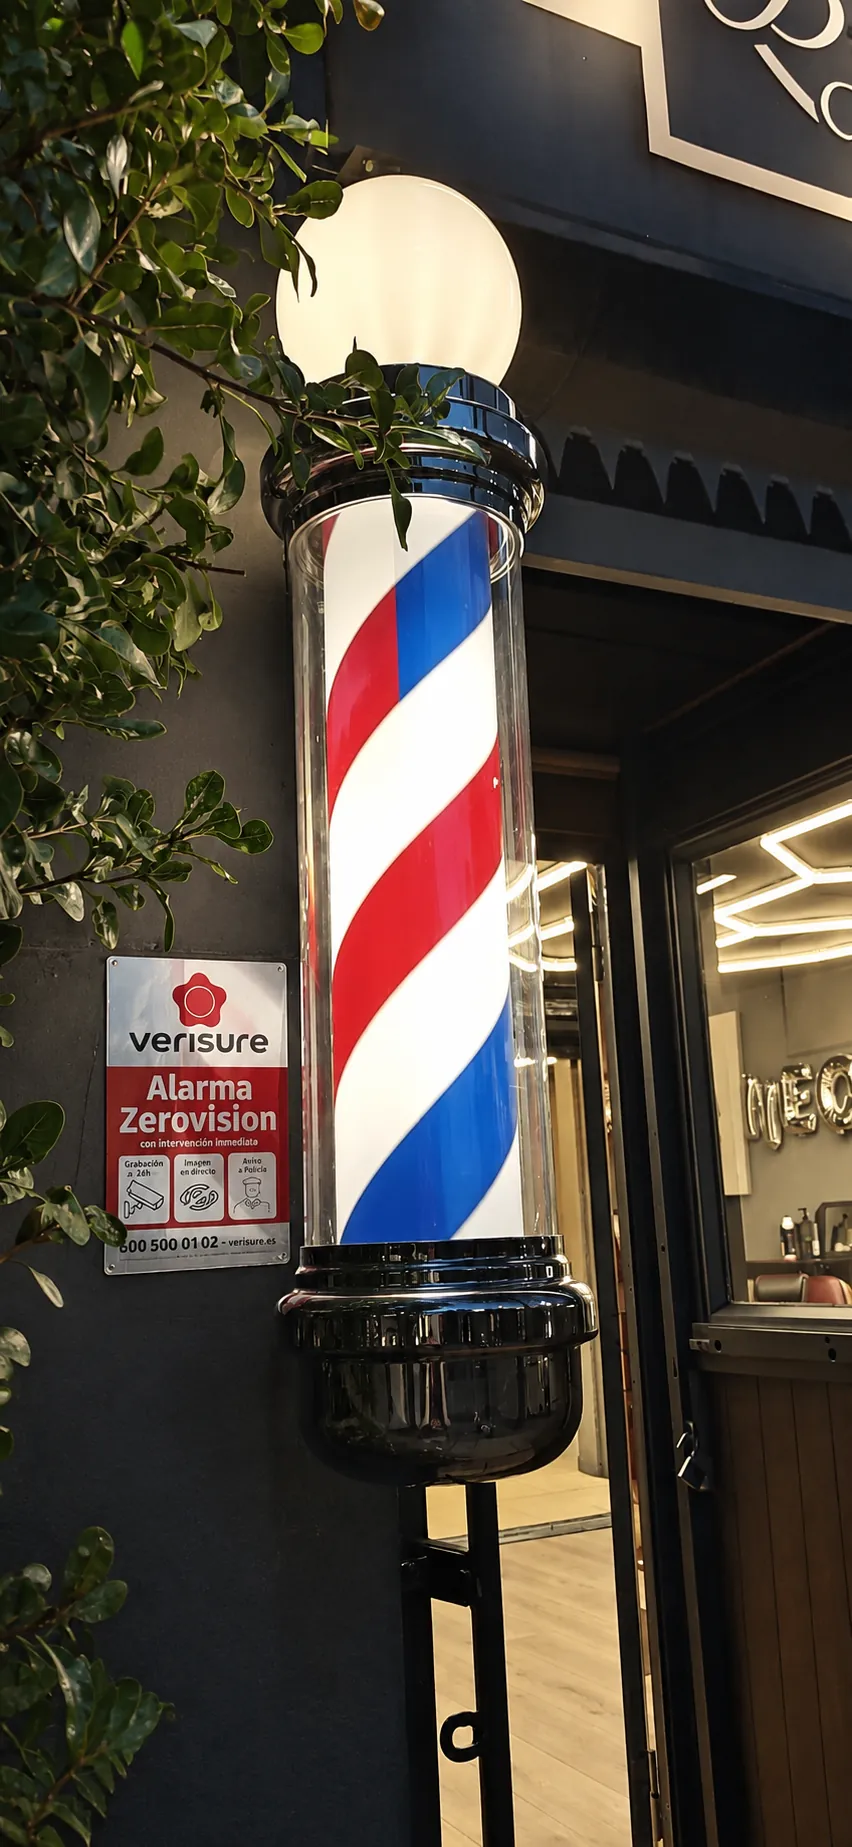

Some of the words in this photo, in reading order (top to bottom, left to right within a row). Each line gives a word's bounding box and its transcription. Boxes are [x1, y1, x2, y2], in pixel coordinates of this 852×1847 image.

[129, 1032, 269, 1054] verisure
[146, 1073, 253, 1101] Alarma
[119, 1103, 277, 1134] Zerovision
[140, 1141, 157, 1149] con
[184, 1159, 212, 1168] Imagen
[191, 1166, 216, 1176] directo
[150, 1238, 178, 1251] 500
[228, 1237, 277, 1247] verisure.es
